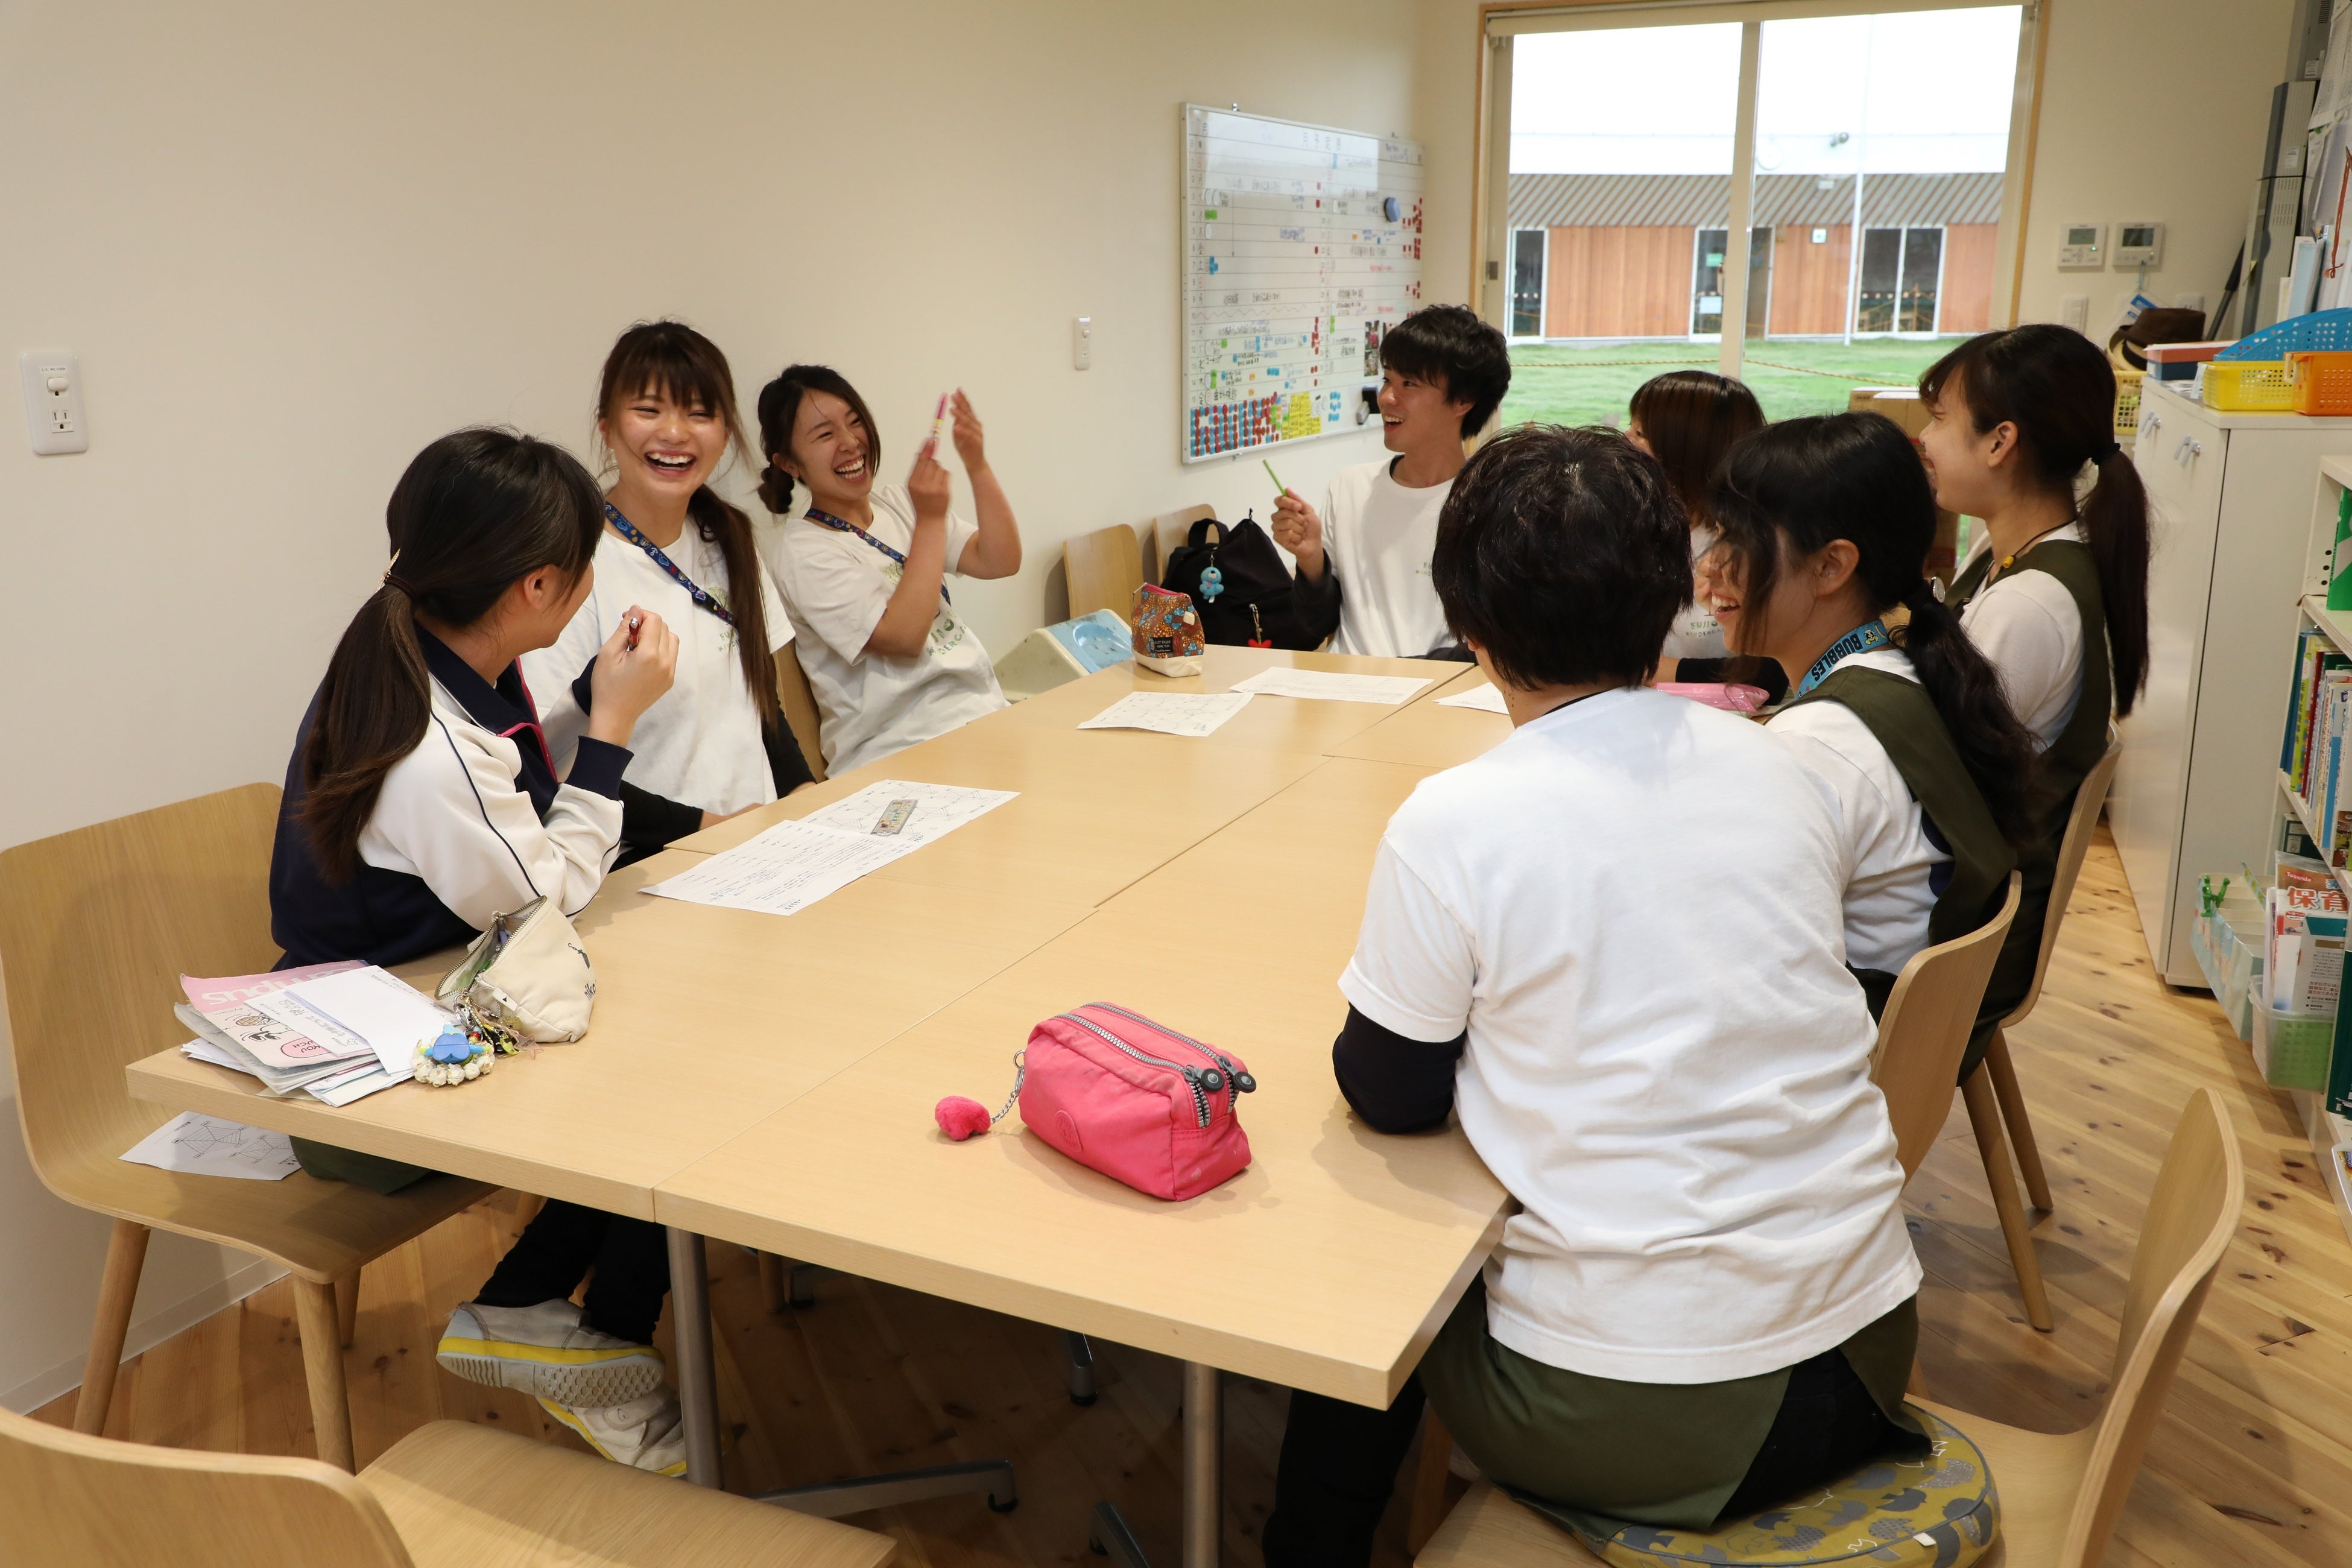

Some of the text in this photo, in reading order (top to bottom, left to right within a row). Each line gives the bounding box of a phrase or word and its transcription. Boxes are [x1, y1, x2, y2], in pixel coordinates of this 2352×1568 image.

[1811, 633, 1864, 681] BUBBLES
[292, 1040, 314, 1048] UCH
[300, 1044, 321, 1053] YOU
